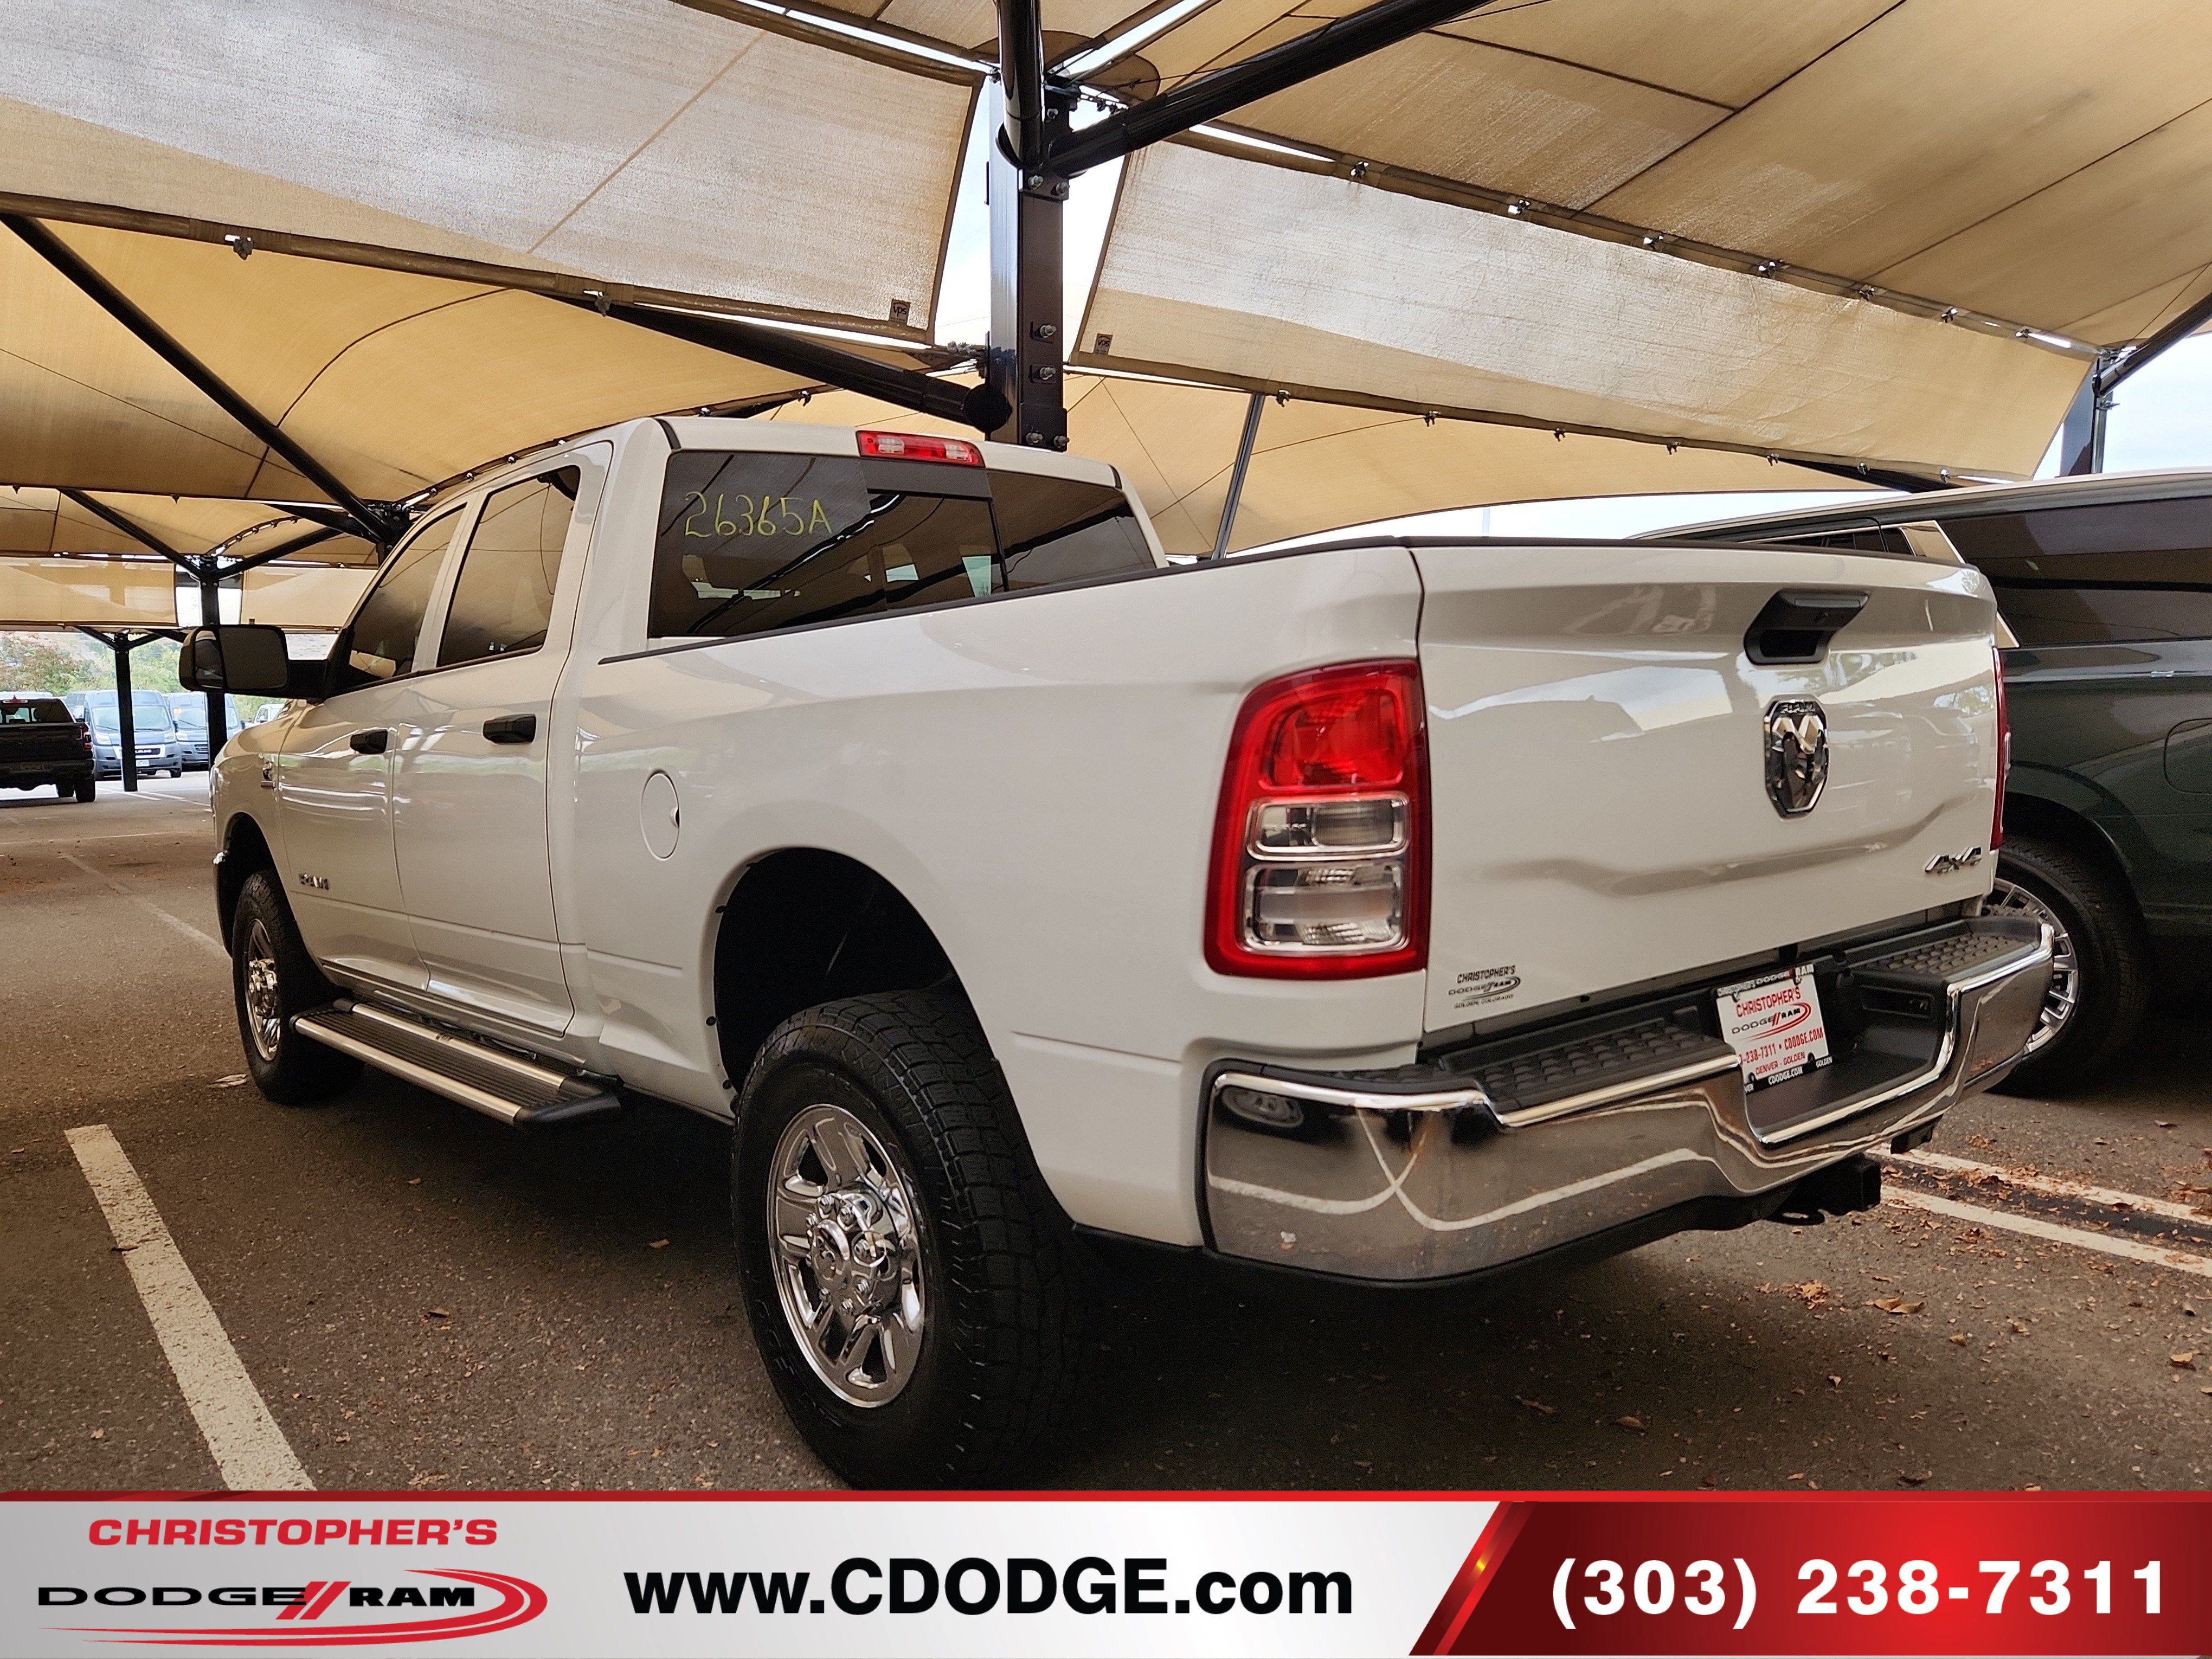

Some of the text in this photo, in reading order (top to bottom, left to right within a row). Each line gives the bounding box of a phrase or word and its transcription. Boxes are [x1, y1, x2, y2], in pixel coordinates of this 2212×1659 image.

[684, 491, 833, 538] 26365A
[1457, 965, 1515, 984] CHRISTOPHER'S
[1736, 987, 1801, 1018] CHRISTOPHER'S
[1732, 1008, 1801, 1034] DODGE RAM
[1784, 1027, 1824, 1051] CDODGE.COM
[1756, 1051, 1805, 1075] DENVER GOLDEN
